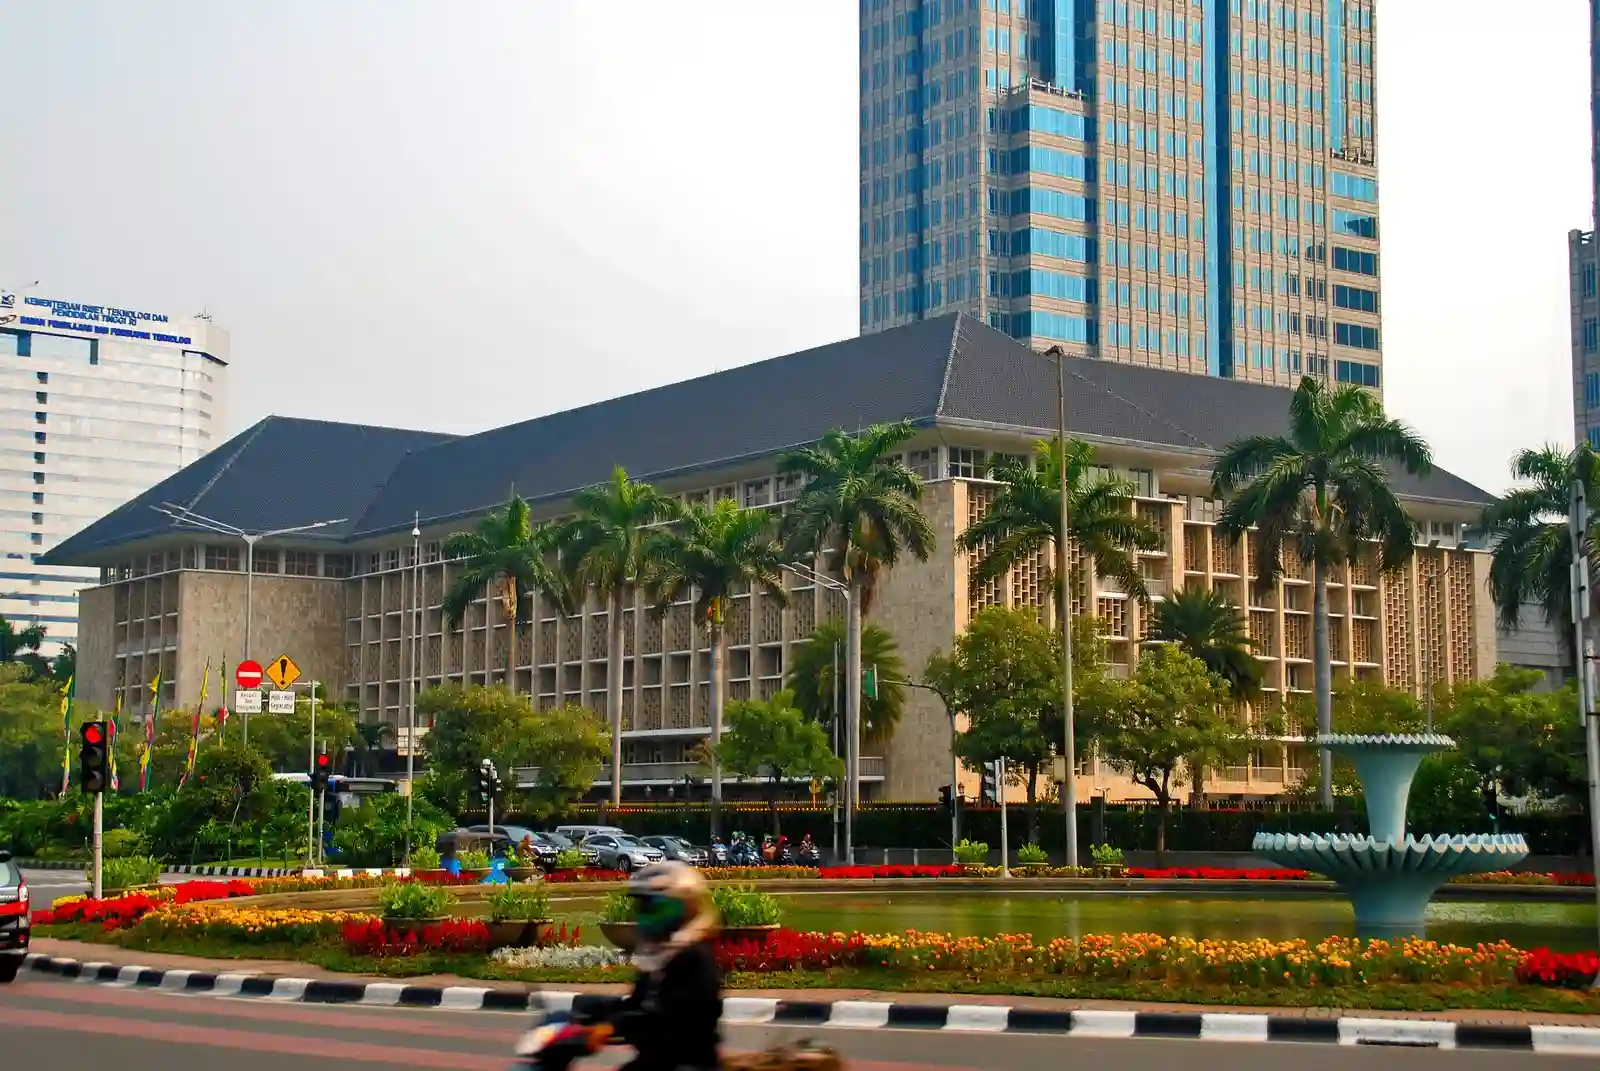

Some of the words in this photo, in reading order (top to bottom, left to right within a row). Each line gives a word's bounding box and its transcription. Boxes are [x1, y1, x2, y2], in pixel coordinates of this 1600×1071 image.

[24, 296, 80, 312] KEMENTERIAN
[81, 304, 104, 315] RISET
[107, 307, 151, 321] TEKNOLOGI
[152, 313, 168, 323] DAN
[52, 308, 99, 321] PENDIDIKAN
[101, 314, 126, 325] TINGGI
[152, 332, 191, 345] TEKNOLOGI
